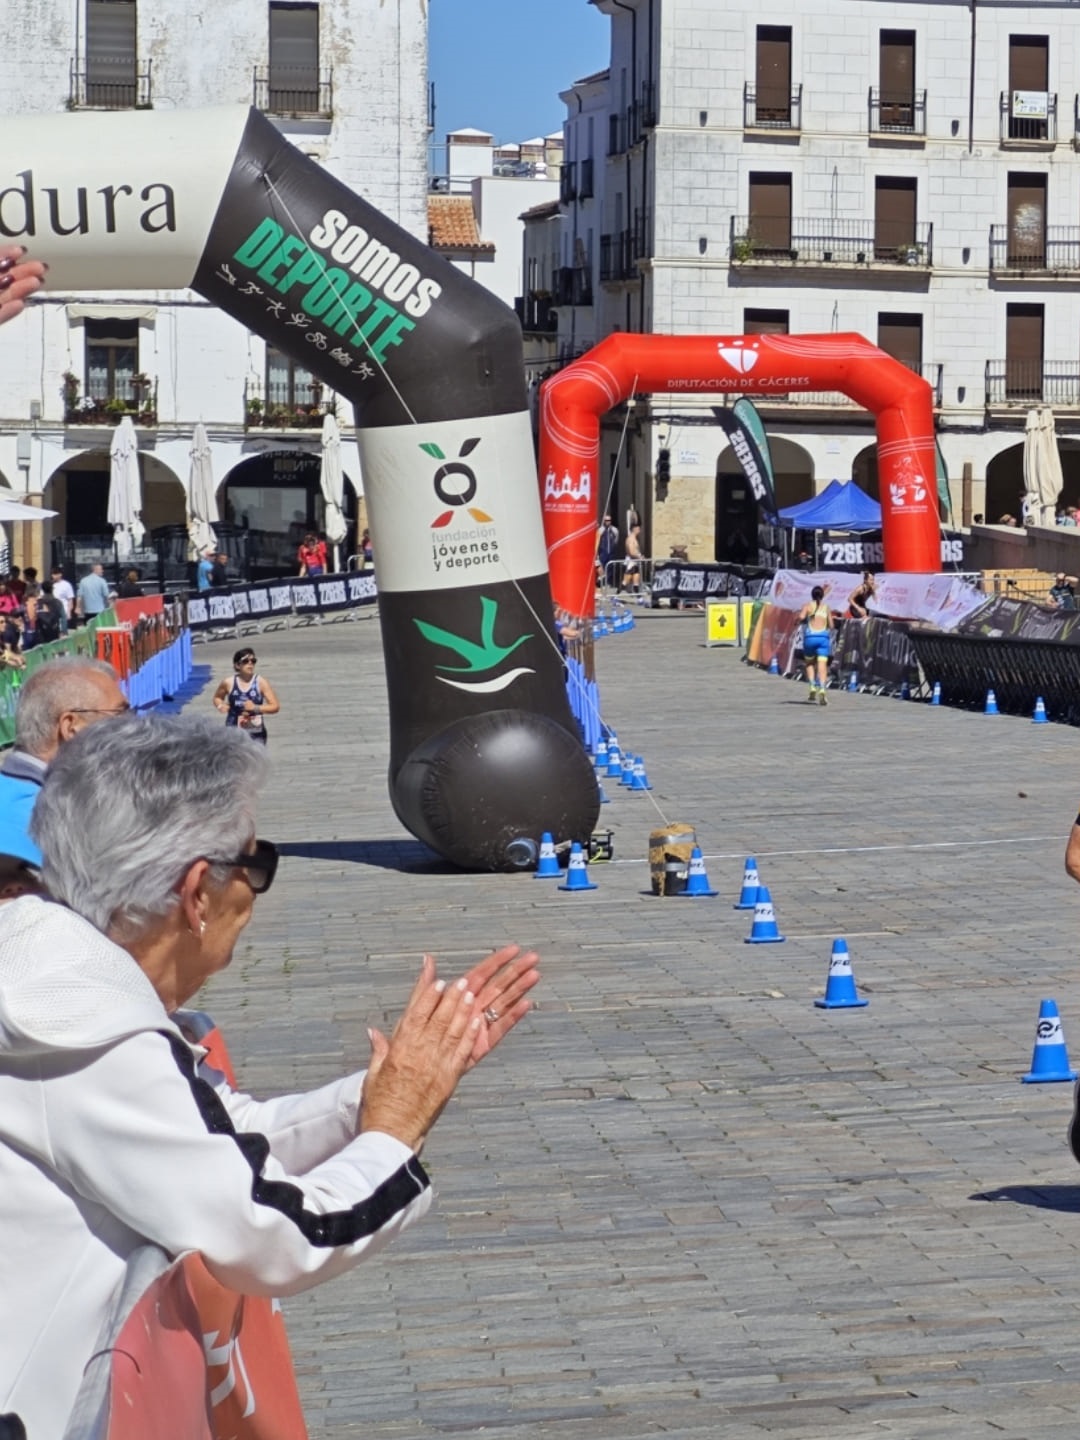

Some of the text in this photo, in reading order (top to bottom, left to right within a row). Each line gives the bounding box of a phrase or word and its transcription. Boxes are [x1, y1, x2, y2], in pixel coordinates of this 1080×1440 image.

[310, 209, 442, 318] SOMOS
[233, 216, 416, 365] DEPORTE
[667, 376, 810, 388] DIPUTACIÓN DE CÁCERES
[431, 526, 497, 544] fundación
[432, 540, 499, 560] jóvenes
[434, 553, 500, 572] y deporte
